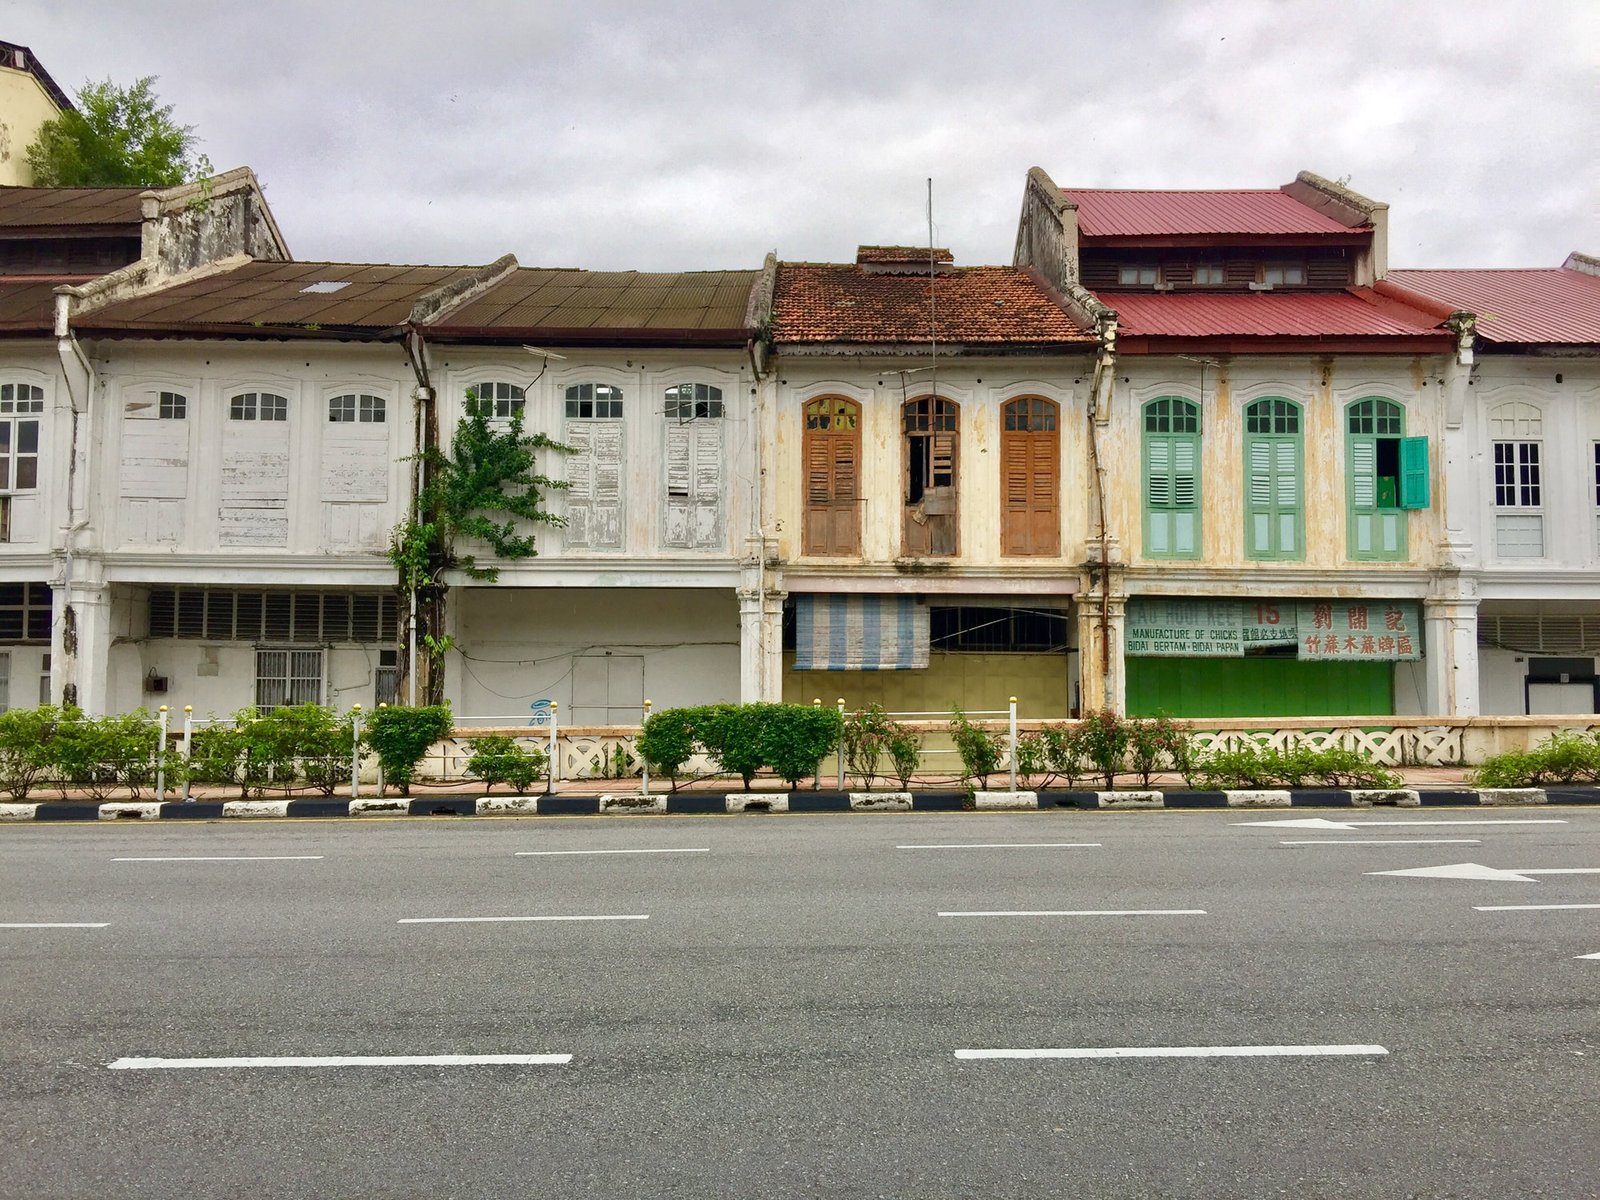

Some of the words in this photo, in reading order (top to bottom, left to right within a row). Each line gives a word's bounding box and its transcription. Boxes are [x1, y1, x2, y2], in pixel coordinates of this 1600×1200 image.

[1255, 603, 1280, 624] 15
[1132, 628, 1190, 640] MANUFACTURE
[1195, 629, 1205, 640] OF
[1210, 630, 1238, 640] CHICKS
[1128, 641, 1149, 651] BIDAI
[1154, 641, 1187, 652] BERTAM
[1192, 642, 1213, 652] BIDAI
[1216, 642, 1240, 652] PAPAN
